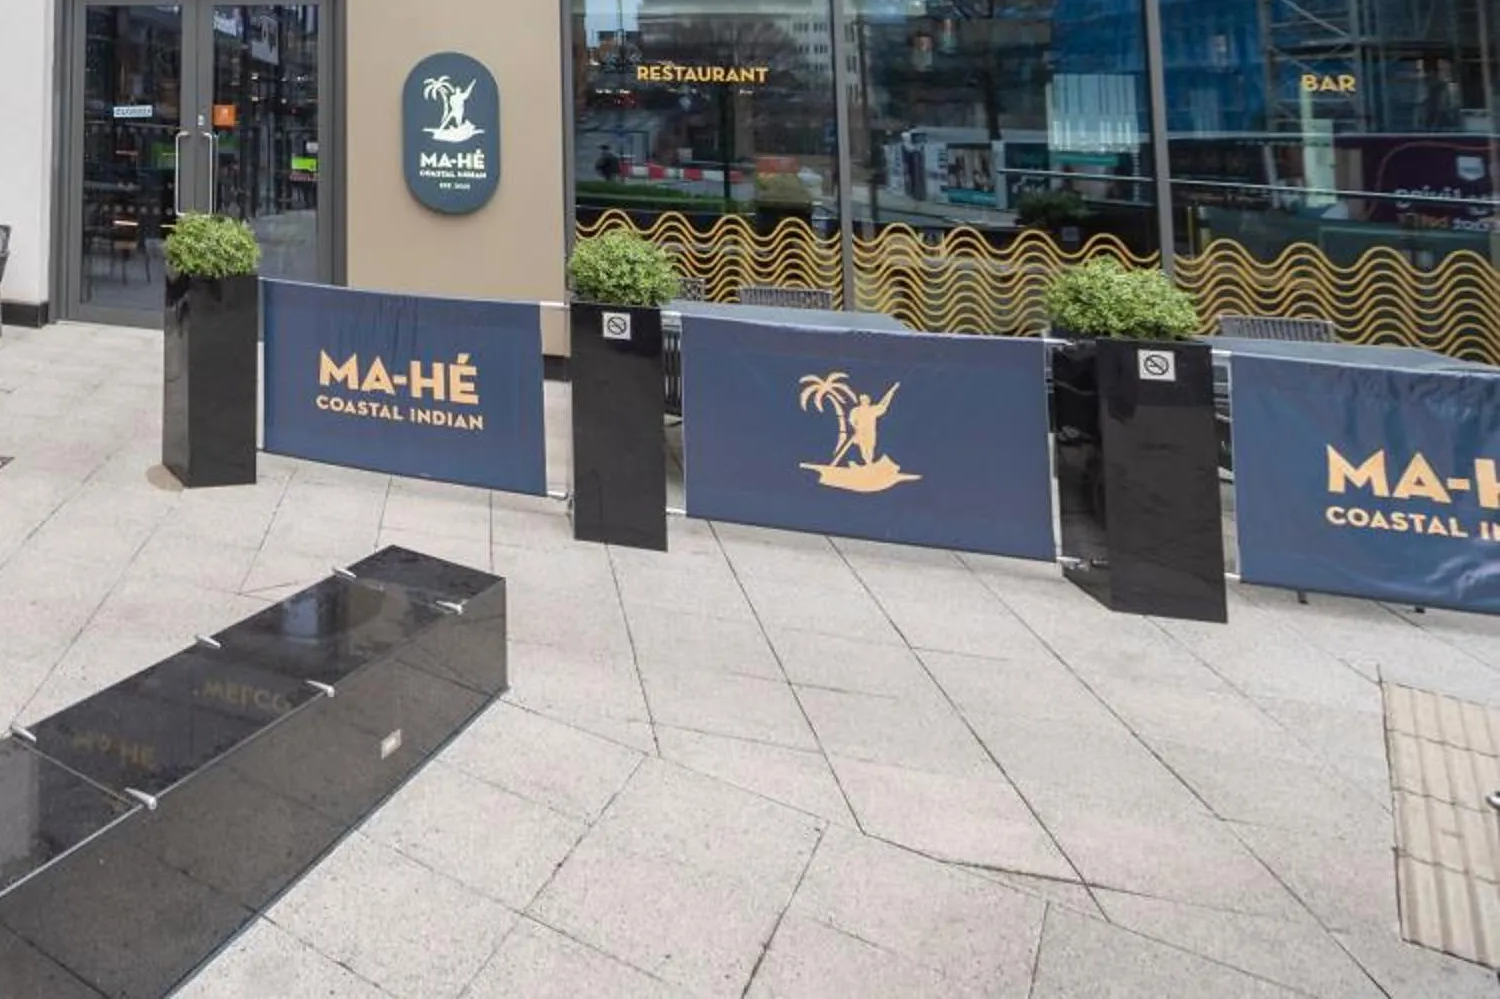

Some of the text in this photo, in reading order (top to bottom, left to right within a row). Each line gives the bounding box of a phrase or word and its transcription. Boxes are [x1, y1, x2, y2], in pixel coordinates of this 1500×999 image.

[636, 65, 769, 82] RESTAURANT
[1301, 74, 1357, 92] BAR
[420, 148, 485, 169] MA-HÉ
[319, 349, 479, 405] MA-HÉ
[315, 394, 484, 430] COASTAL INDIAN
[1325, 506, 1469, 538] COASTAL
